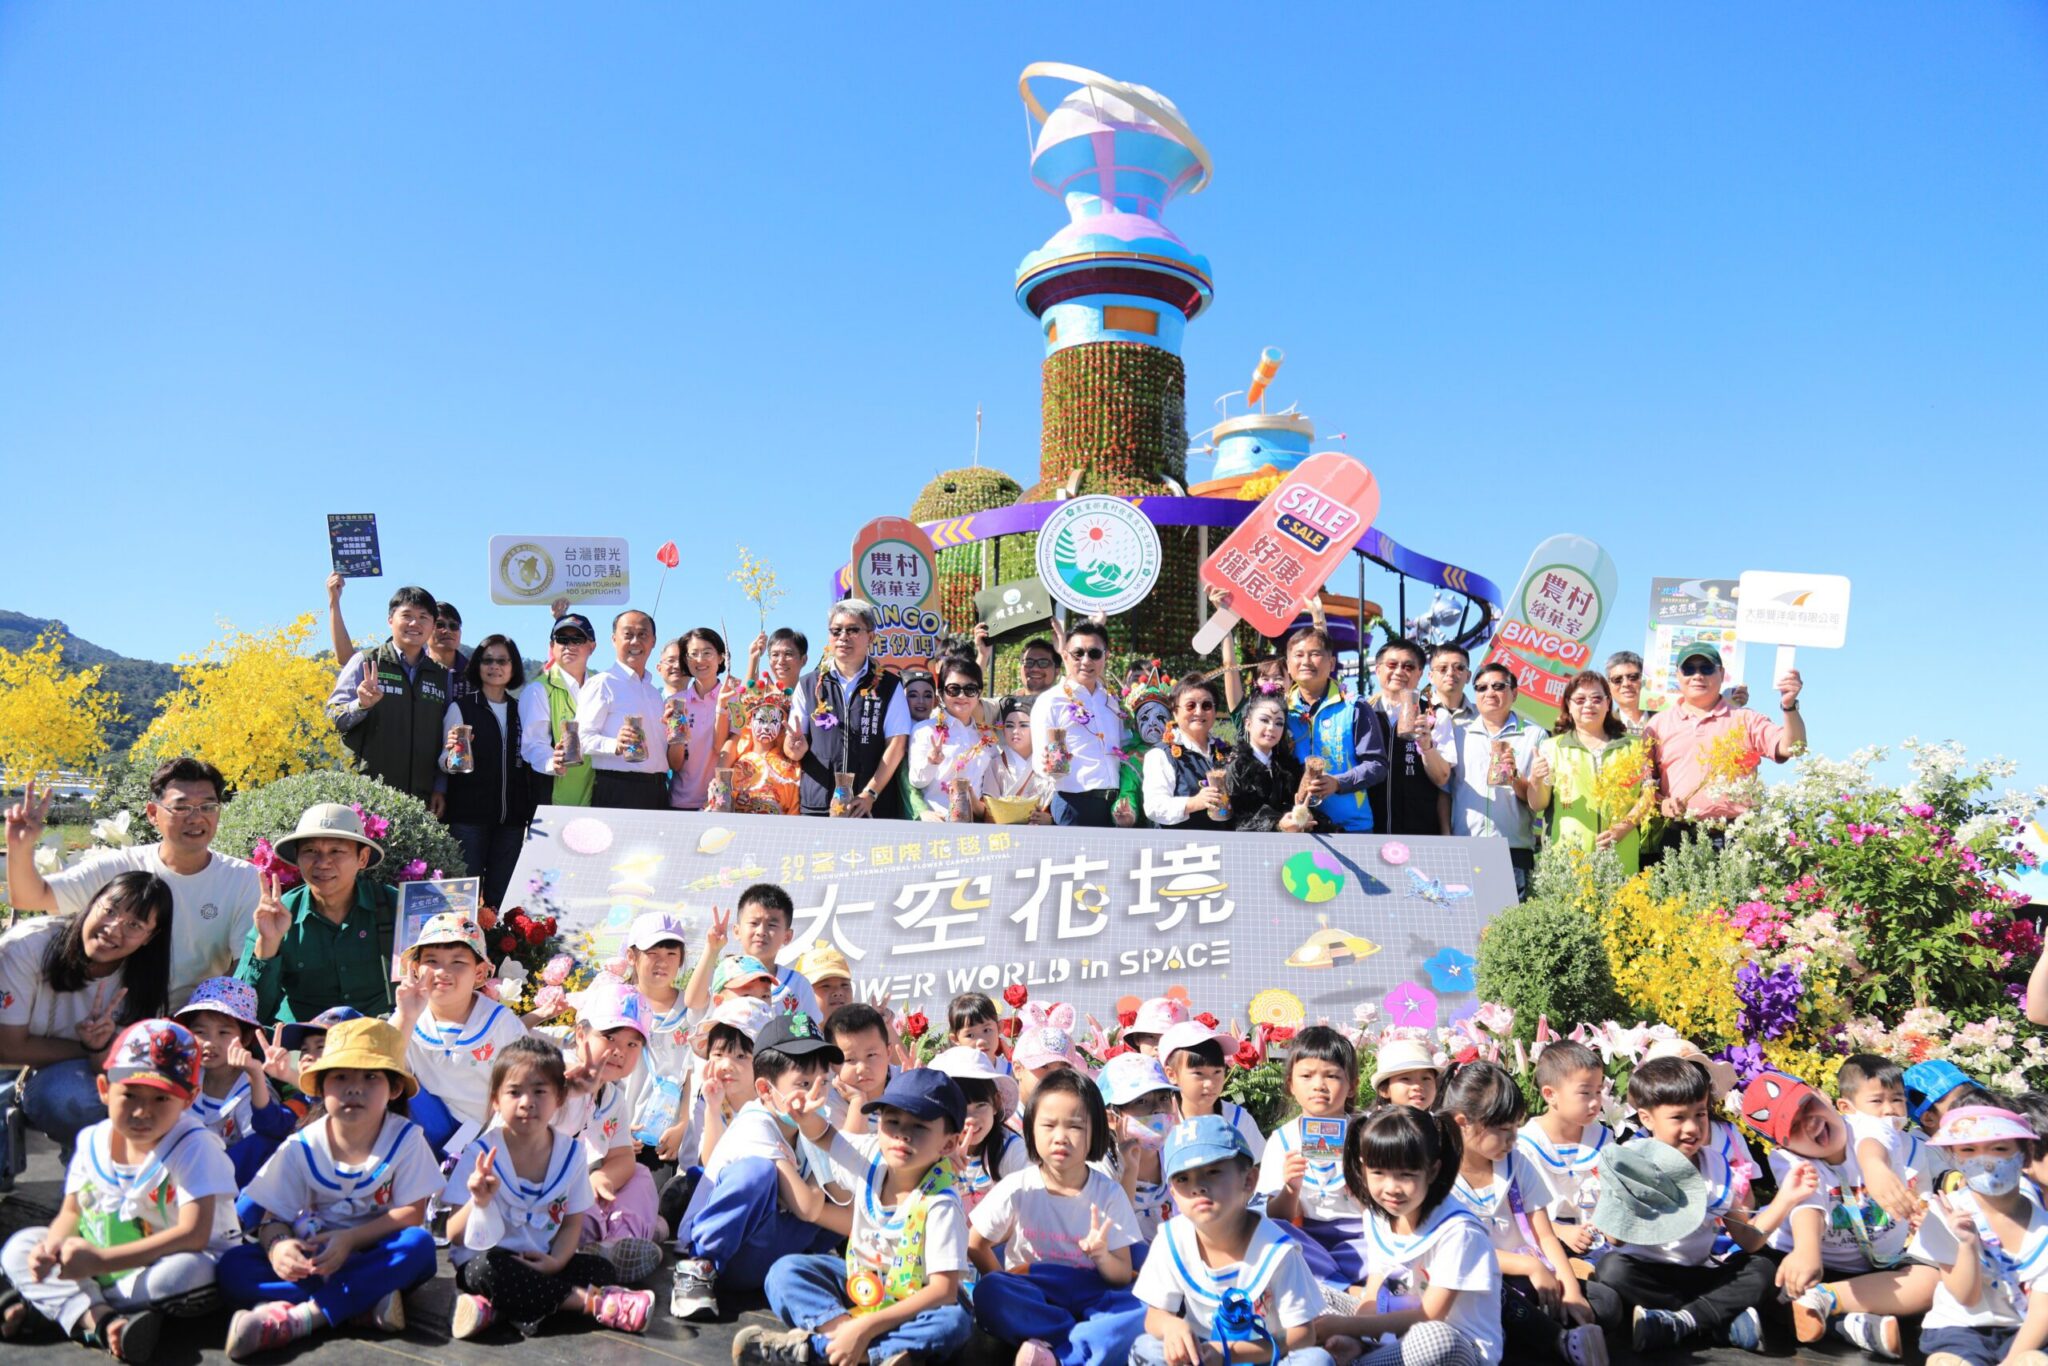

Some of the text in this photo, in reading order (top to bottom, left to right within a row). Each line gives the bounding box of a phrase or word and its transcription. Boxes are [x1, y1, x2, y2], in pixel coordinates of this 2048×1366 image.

[1283, 489, 1350, 534] SALE
[1289, 522, 1324, 547] SALE
[565, 547, 621, 561] 台灣觀光
[871, 552, 919, 577] 農村
[1249, 535, 1304, 585] 好康
[871, 580, 921, 597] 繽菓室
[1216, 549, 1293, 617] 攏底家
[1539, 573, 1595, 616] 農村
[872, 604, 940, 635] INGO
[1529, 600, 1583, 638] 繽菓室
[869, 634, 934, 656] 作伙呷
[1502, 622, 1585, 662] BINGO!
[1405, 742, 1415, 776] 張敬昌
[852, 865, 911, 877] INTERNATIONAL
[913, 860, 944, 869] FLOWER
[946, 857, 974, 866] CARPET
[977, 853, 1011, 863] FESTIVAL
[775, 843, 1236, 967] 太空花境
[947, 958, 1071, 993] WORLD
[1081, 958, 1110, 981] in
[1119, 939, 1231, 977] SPACE
